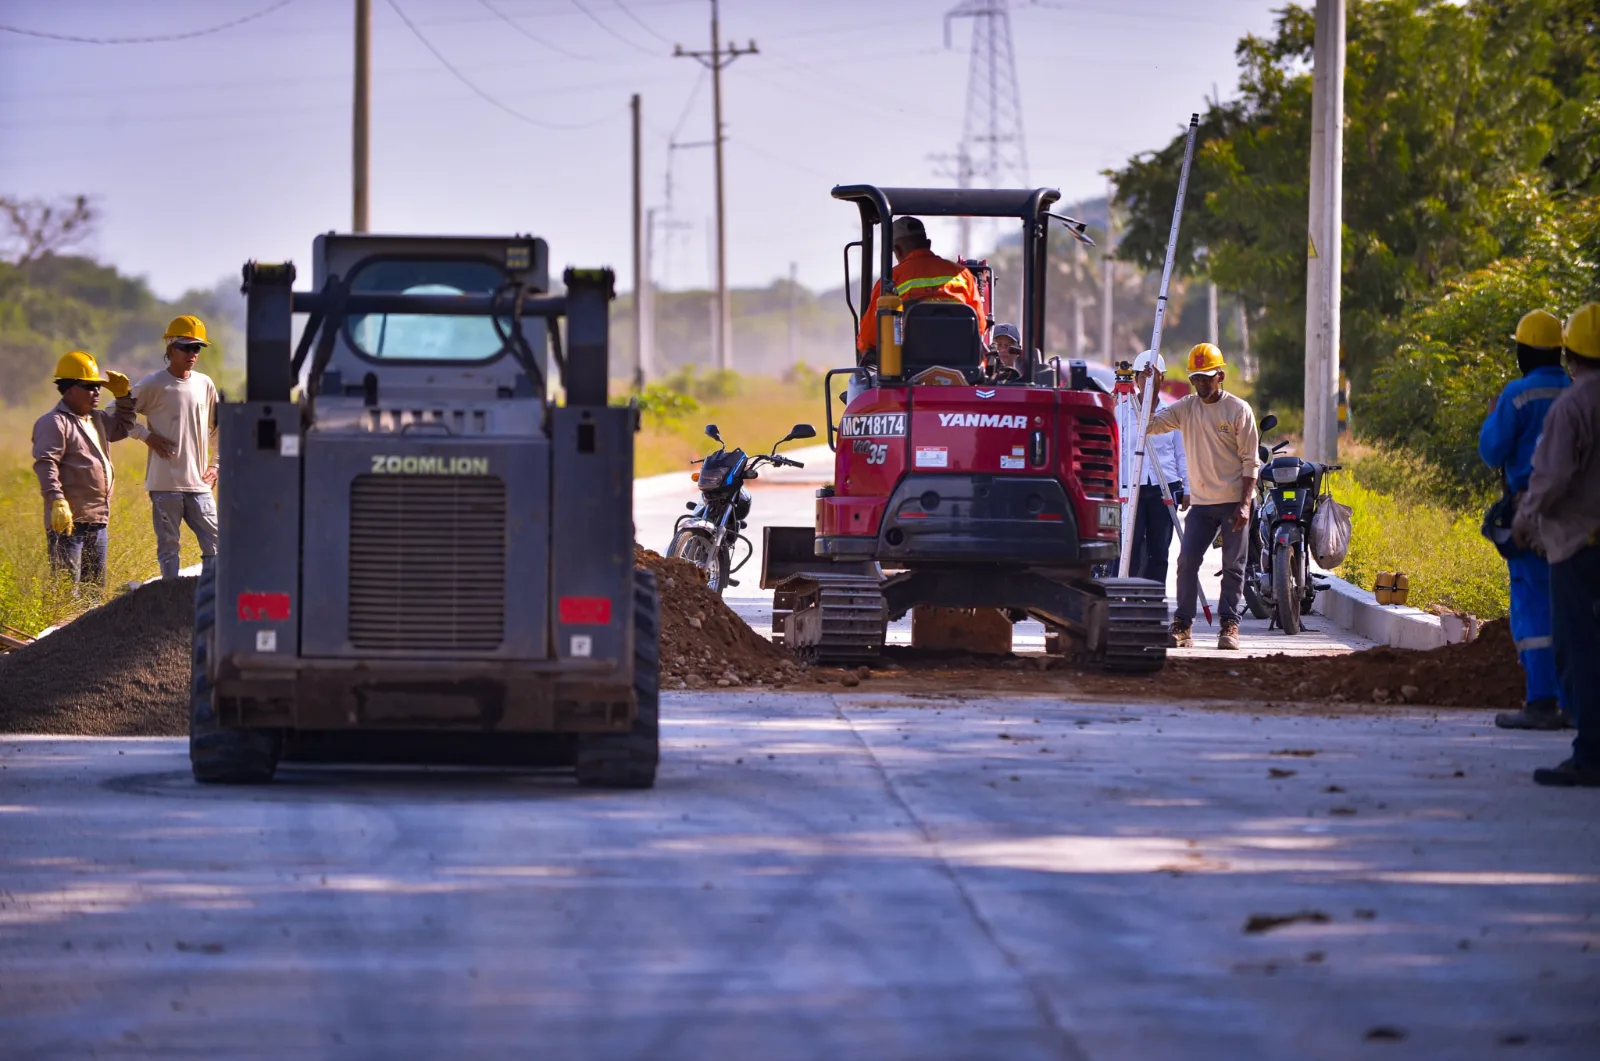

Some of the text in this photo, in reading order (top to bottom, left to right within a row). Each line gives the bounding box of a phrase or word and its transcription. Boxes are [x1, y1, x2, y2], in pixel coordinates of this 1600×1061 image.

[842, 415, 905, 436] MC718174
[938, 413, 1028, 429] YANMAR
[371, 455, 489, 474] ZOOMLION
[866, 444, 889, 465] 35
